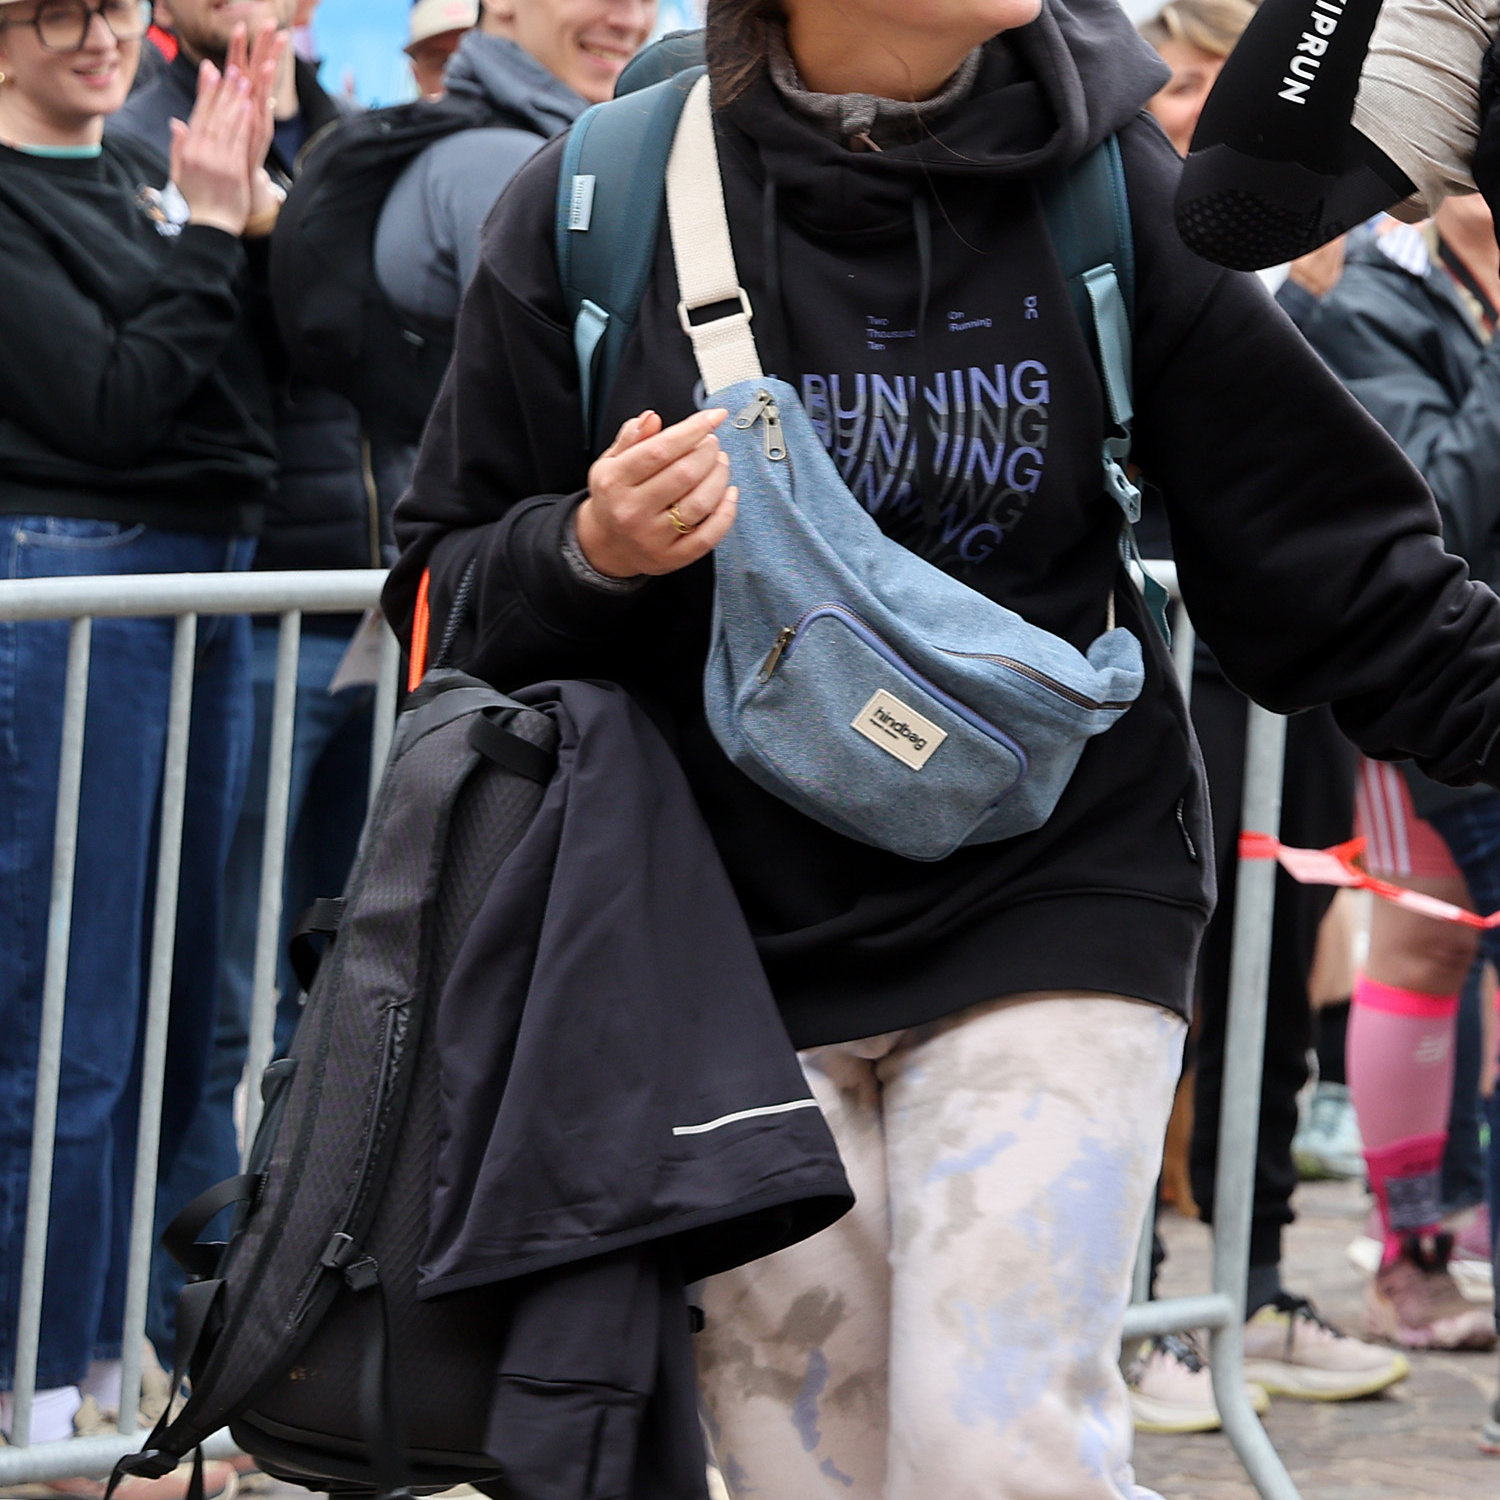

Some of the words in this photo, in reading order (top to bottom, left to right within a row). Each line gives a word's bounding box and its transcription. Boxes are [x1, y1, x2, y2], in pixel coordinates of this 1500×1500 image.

[866, 315, 889, 326] Two
[949, 318, 993, 332] Running
[866, 328, 916, 339] Thousand
[866, 341, 886, 351] Ten
[873, 706, 928, 751] hindbag
